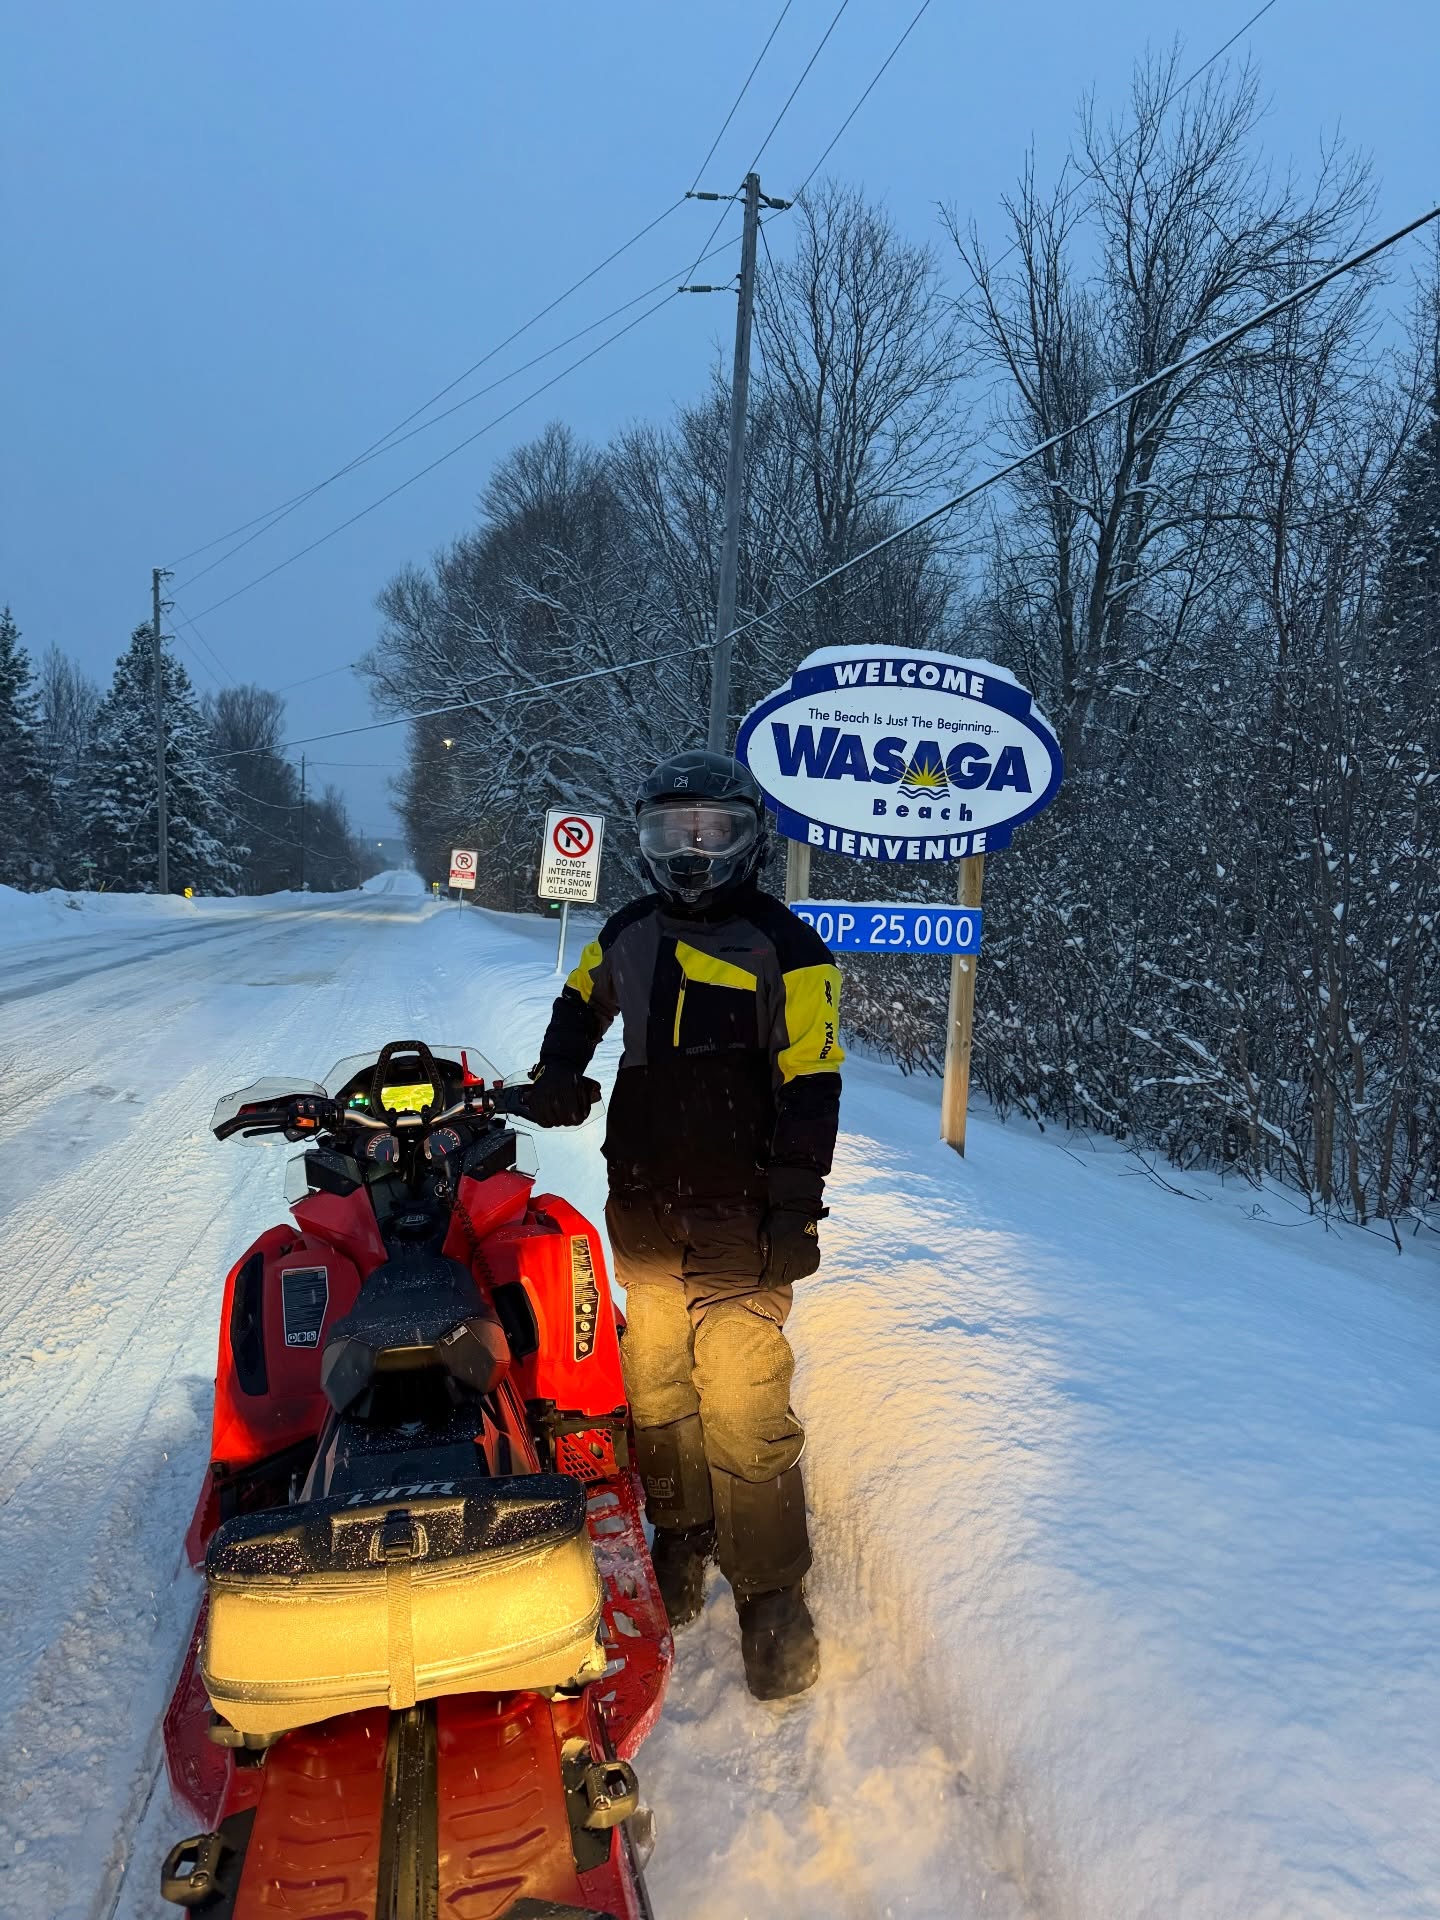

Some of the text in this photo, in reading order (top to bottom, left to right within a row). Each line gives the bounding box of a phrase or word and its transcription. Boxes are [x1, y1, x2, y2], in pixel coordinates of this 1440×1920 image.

[834, 661, 986, 699] WELCOME
[808, 707, 1000, 736] The Beach Is Just The Beginning...
[771, 722, 1033, 794] WASAGA
[872, 798, 973, 822] Beach
[807, 822, 987, 861] BIENVENUE
[548, 867, 592, 879] INTERFERE
[555, 858, 587, 868] DO NOT
[546, 876, 592, 888] WITH SNOW
[548, 885, 588, 897] CLEARING
[869, 914, 973, 948] 25,000
[819, 1021, 834, 1060] ROTAX
